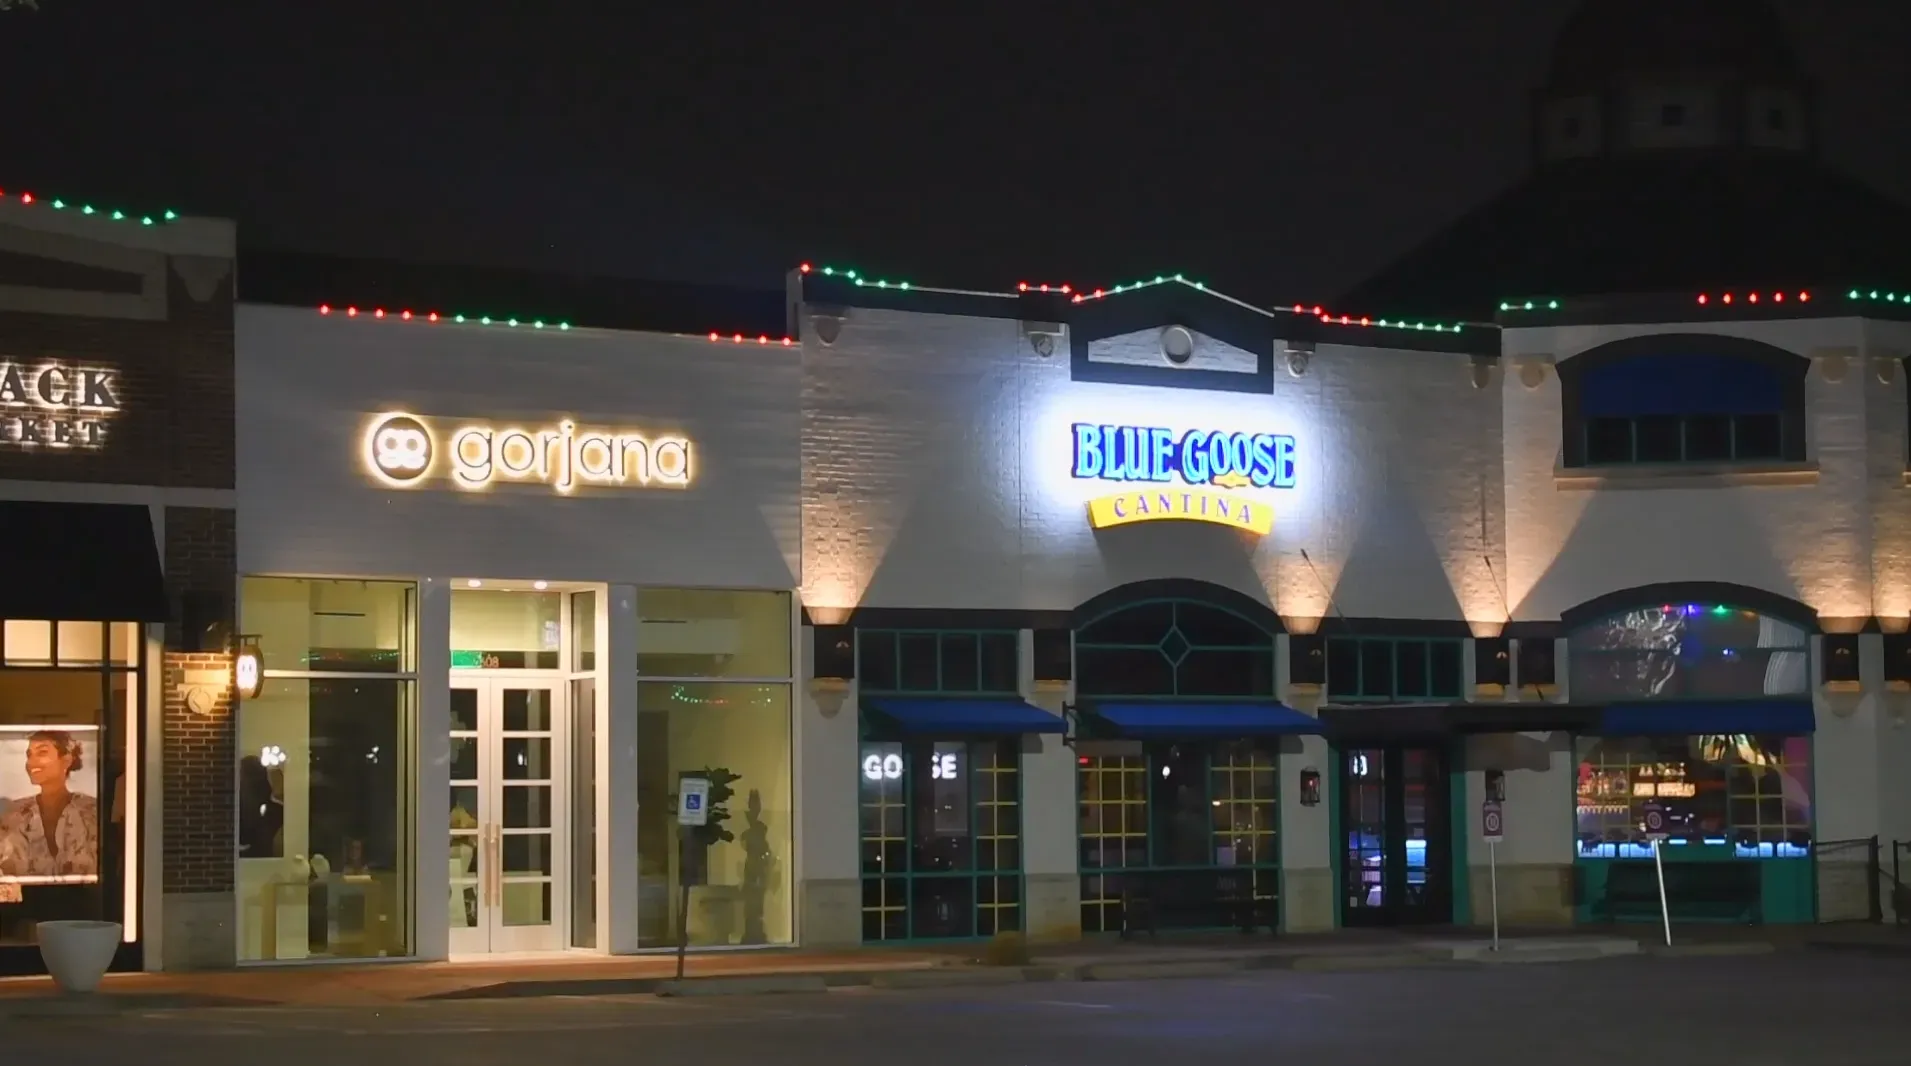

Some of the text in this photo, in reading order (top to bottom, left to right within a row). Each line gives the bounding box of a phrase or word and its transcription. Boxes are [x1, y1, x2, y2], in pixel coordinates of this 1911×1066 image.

[457, 422, 690, 487] gorjana
[1071, 423, 1296, 489] BLUE GOOSE
[1113, 493, 1252, 525] CANTINA
